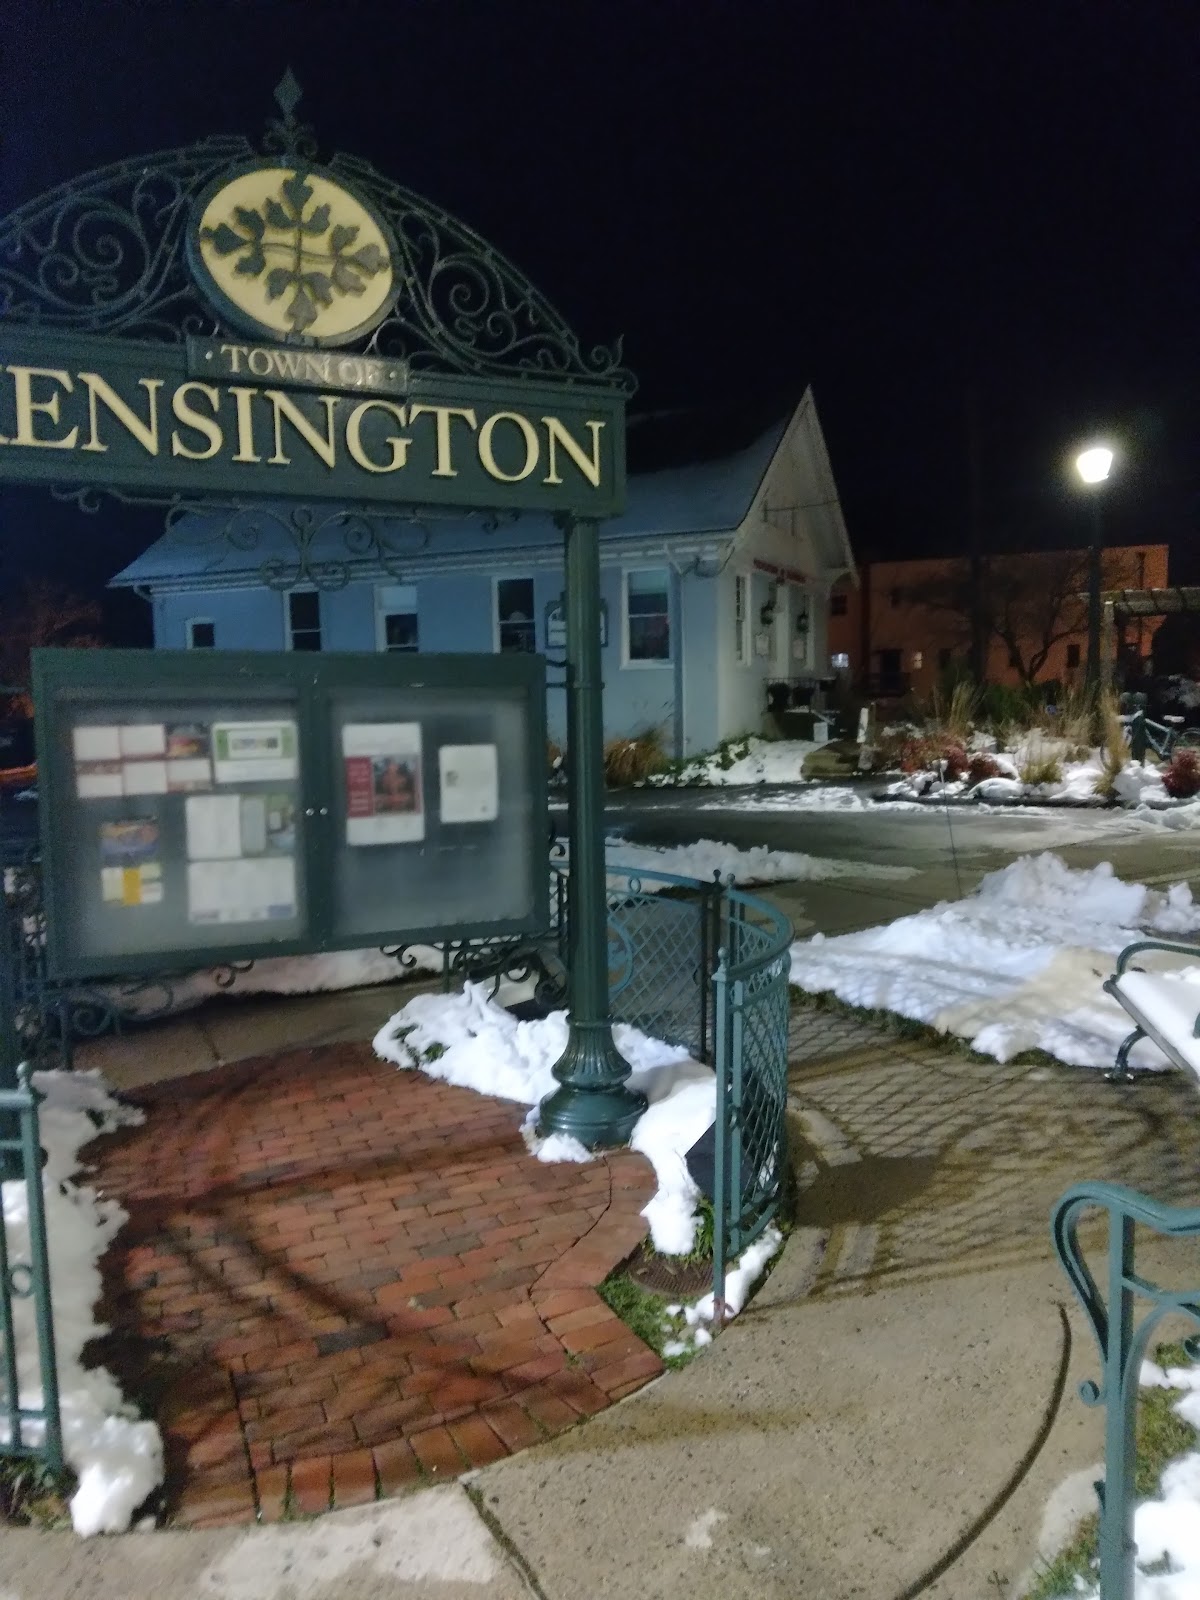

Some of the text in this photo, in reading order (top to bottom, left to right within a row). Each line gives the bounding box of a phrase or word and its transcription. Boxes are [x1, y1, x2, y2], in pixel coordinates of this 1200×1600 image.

[221, 344, 386, 387] TOWN OF
[0, 364, 606, 487] ENSINGTON
